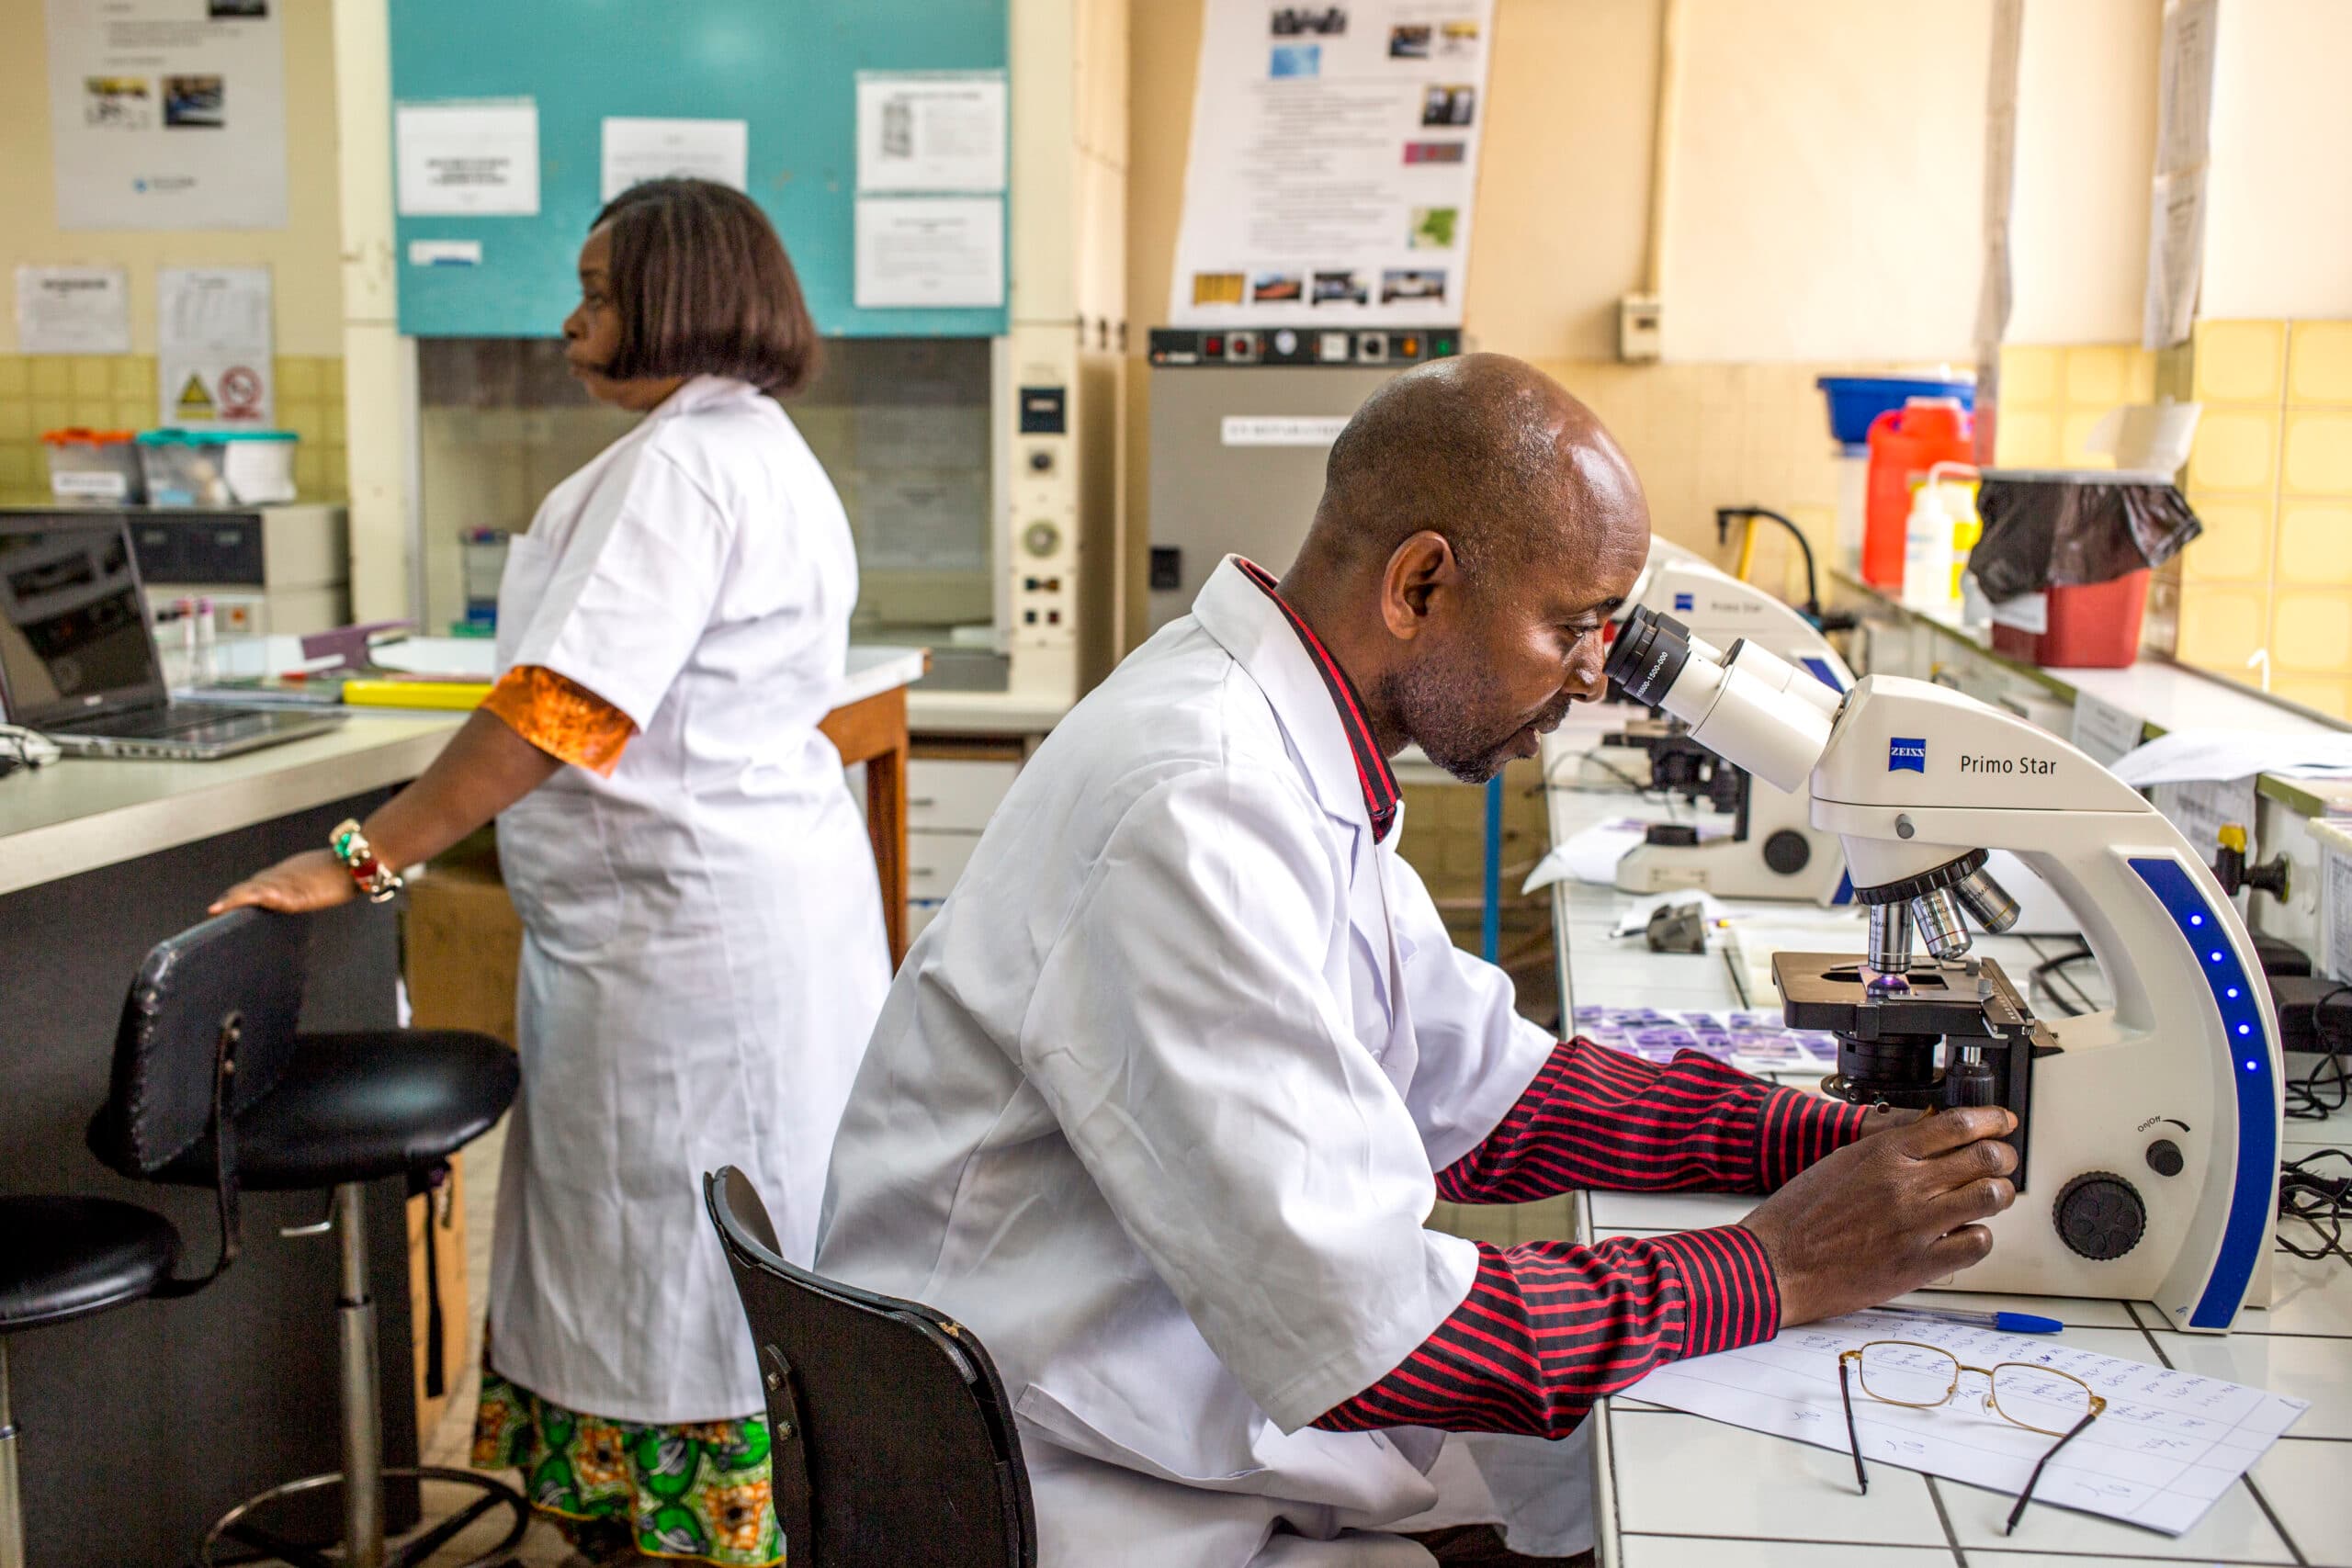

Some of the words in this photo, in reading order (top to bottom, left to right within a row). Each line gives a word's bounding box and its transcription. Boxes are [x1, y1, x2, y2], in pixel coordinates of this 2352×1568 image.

[1891, 747, 1925, 757] ZEISS
[1961, 755, 2013, 773] Primo
[2019, 757, 2057, 774] Star
[2137, 1115, 2161, 1133] On/Off
